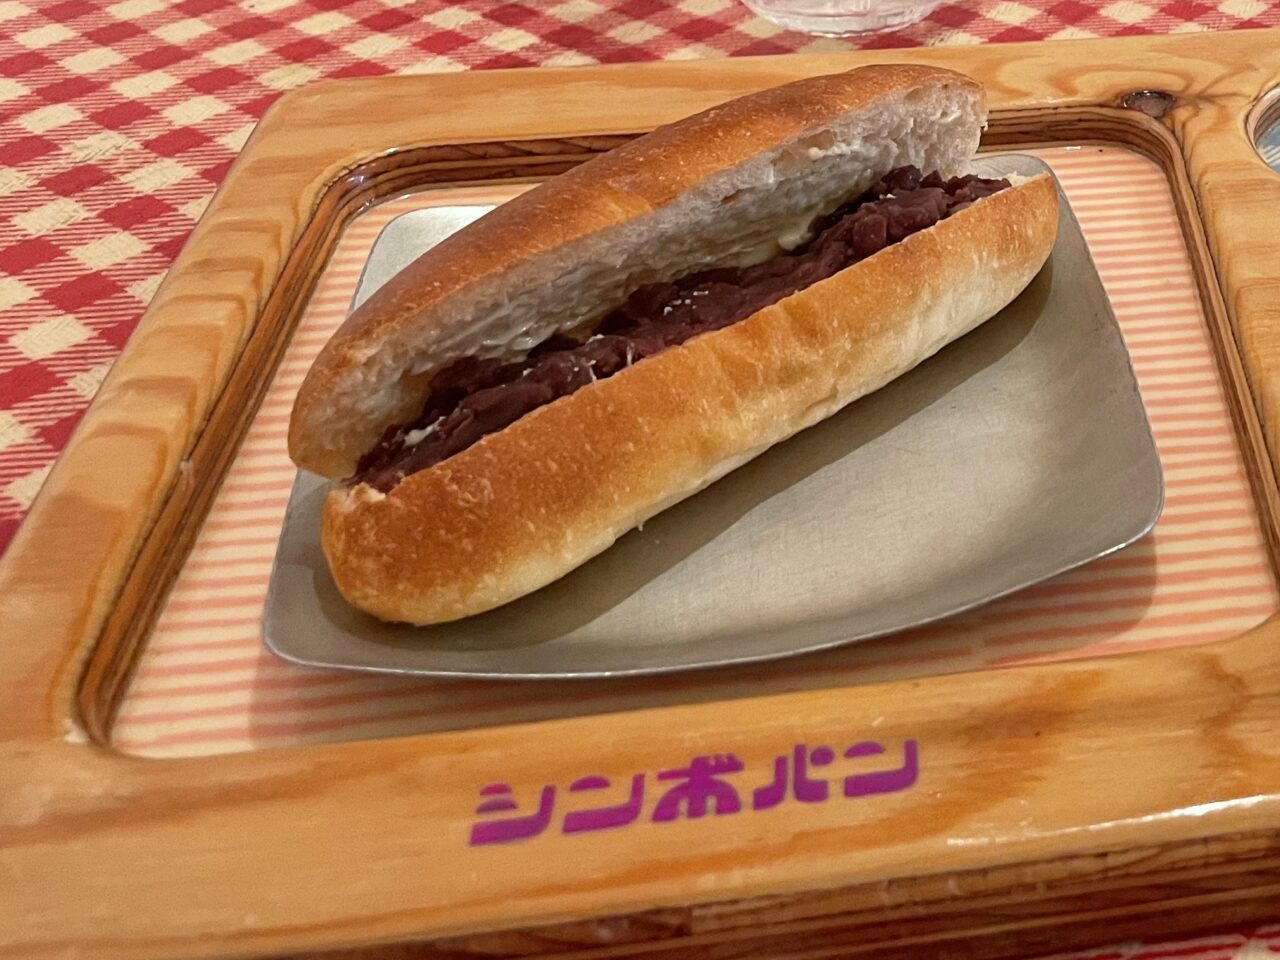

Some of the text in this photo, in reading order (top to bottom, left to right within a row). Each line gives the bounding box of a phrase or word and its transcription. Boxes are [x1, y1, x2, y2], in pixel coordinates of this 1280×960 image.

[469, 739, 919, 846] シンボパン
